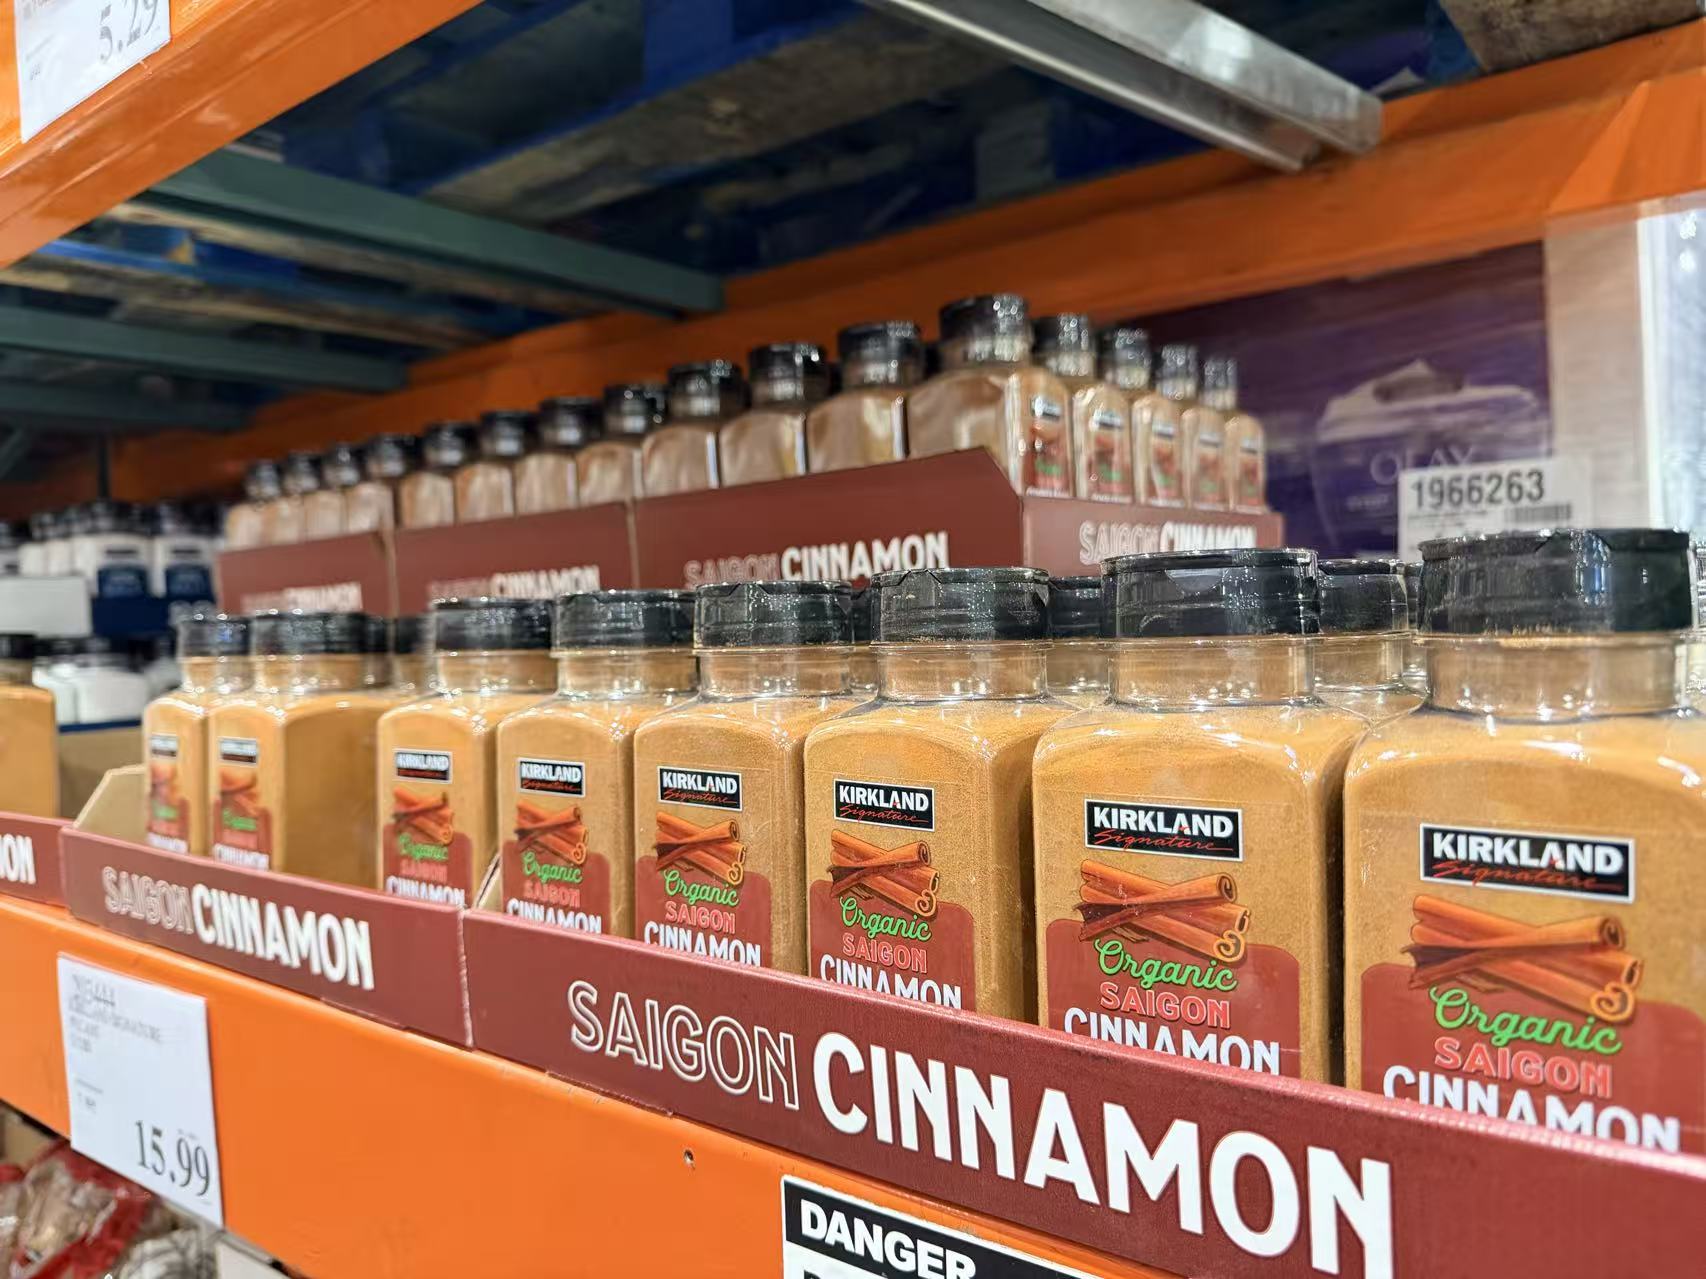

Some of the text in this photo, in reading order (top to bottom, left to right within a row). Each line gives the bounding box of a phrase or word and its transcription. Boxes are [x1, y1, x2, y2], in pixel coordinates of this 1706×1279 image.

[1410, 468, 1545, 509] 1966263
[781, 530, 949, 582] CINNAMON
[520, 762, 582, 783] KIRKLAND
[662, 771, 738, 794] KIRKLAND
[839, 784, 929, 811] KIRKLAND
[839, 804, 929, 823] Signature
[1093, 806, 1234, 838] KIRKLAND
[1093, 828, 1234, 851] Signature
[521, 851, 583, 884] Organic
[1432, 832, 1624, 875] KIRKLAND
[663, 868, 739, 907] Organic
[192, 882, 375, 991] CINNAMON
[506, 897, 602, 933] CINNAMON
[665, 900, 736, 934] SAIGON
[839, 896, 932, 941] Organic
[643, 920, 761, 967] CINNAMON
[842, 932, 928, 974] SAIGON
[1093, 938, 1239, 992] Organic
[820, 953, 963, 1009] CINNAMON
[1099, 981, 1232, 1029] SAIGON
[1429, 984, 1623, 1055] Organic
[1064, 1007, 1280, 1076] CINNAMON
[1433, 1036, 1613, 1099] SAIGON
[567, 980, 1394, 1279] SAIGON CINNAMON
[1382, 1064, 1681, 1154] CINNAMON
[136, 1119, 210, 1197] 15.99
[800, 1198, 977, 1279] DANGER
